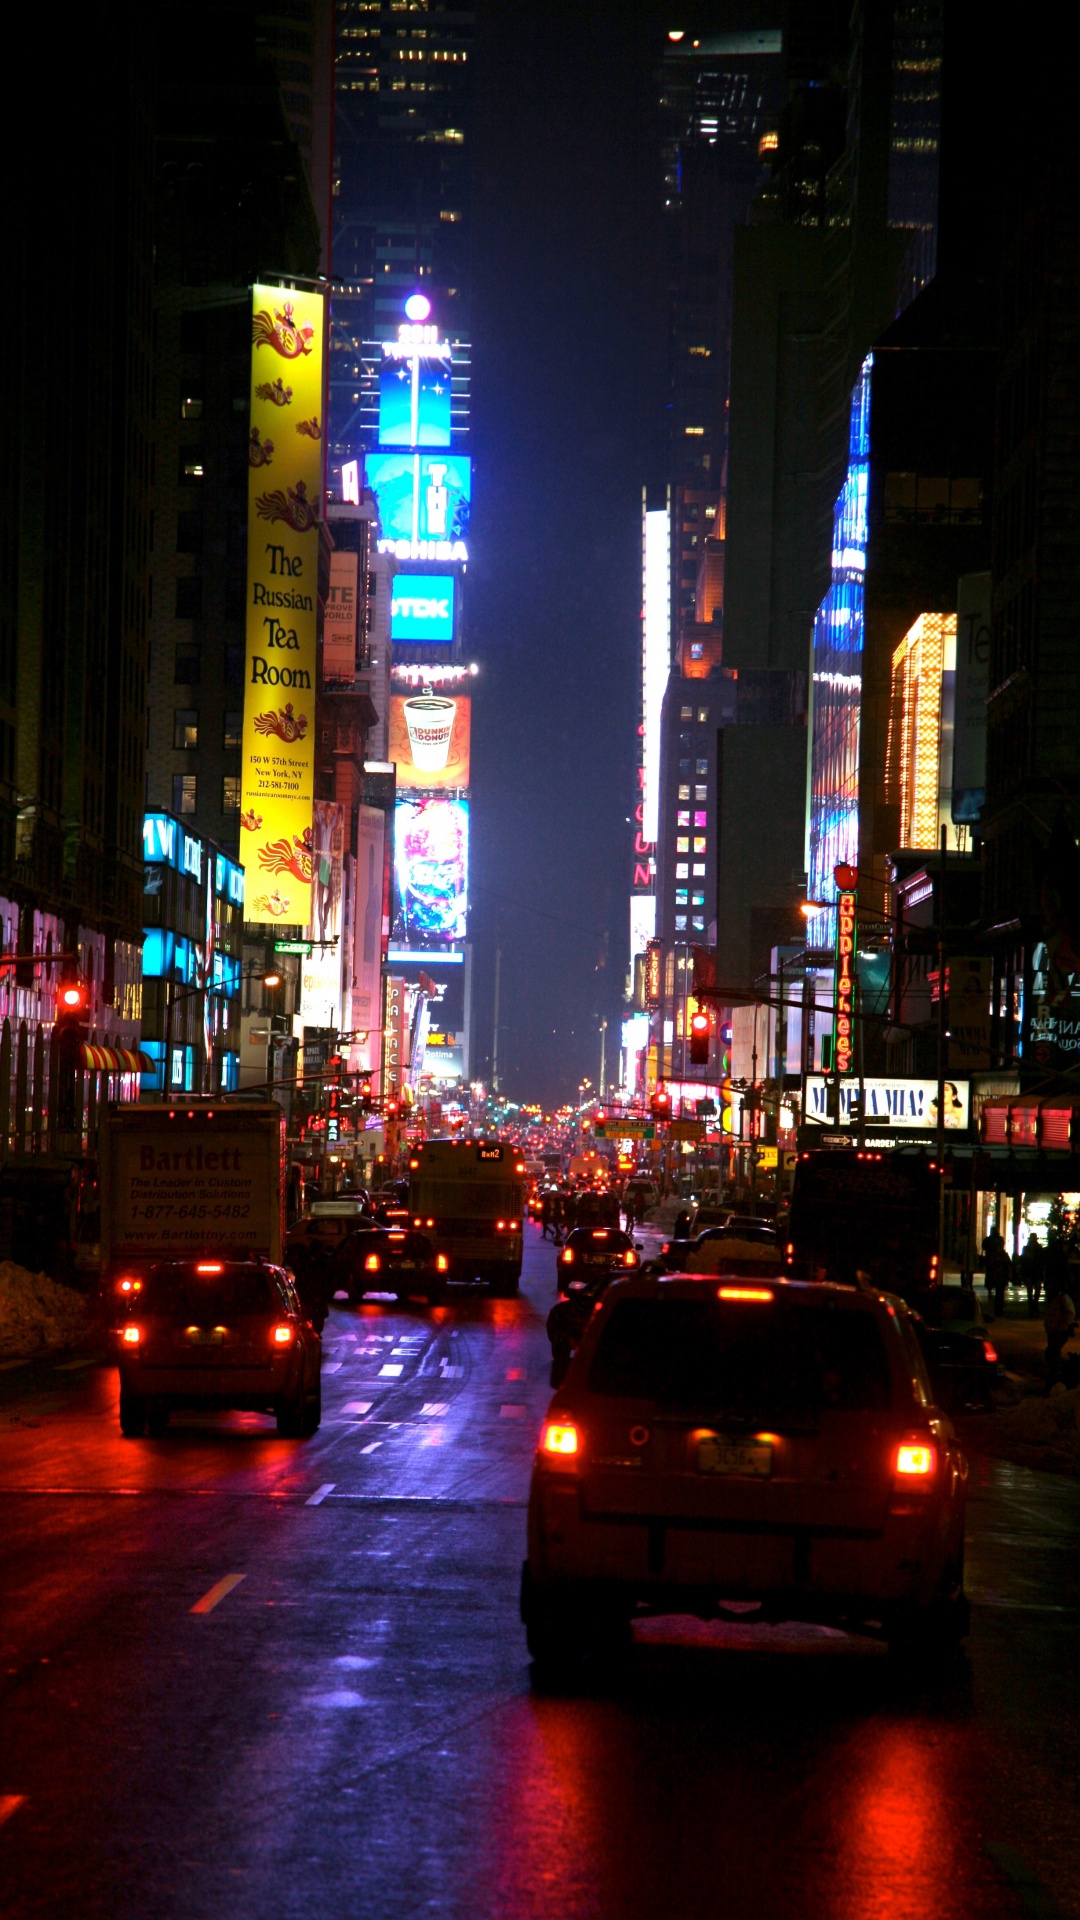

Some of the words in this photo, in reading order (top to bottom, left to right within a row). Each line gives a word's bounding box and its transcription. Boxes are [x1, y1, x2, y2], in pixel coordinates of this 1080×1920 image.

[377, 539, 469, 560] OSHIBA
[266, 543, 303, 577] The
[253, 583, 313, 611] Russian
[397, 597, 449, 618] TDK
[263, 616, 300, 650] Tea
[251, 656, 311, 689] Room
[417, 732, 450, 741] DONUTS
[250, 755, 261, 764] 150
[263, 756, 270, 764] W
[272, 757, 287, 766] 57th
[288, 759, 309, 768] Street
[255, 767, 271, 776] New
[273, 769, 291, 779] York,
[292, 771, 303, 779] NY
[258, 779, 300, 791] 212-581-7100
[246, 791, 311, 801] russiantearoomnyc.com
[388, 988, 399, 1082] PALACE
[424, 1050, 454, 1059] Optima
[811, 1087, 879, 1116] MMA
[885, 1089, 925, 1117] MIA!
[328, 1119, 338, 1141] BAR
[865, 1139, 896, 1149] GARDEN
[140, 1145, 243, 1171] Bartlett
[130, 1178, 150, 1187] The
[153, 1178, 191, 1188] Leader
[194, 1178, 204, 1187] in
[208, 1178, 252, 1187] Custom
[130, 1190, 195, 1200] Distribution
[199, 1190, 251, 1200] Solutions
[131, 1205, 251, 1219] 1-877-645-5482
[124, 1230, 258, 1241] www.Bartlettny.com
